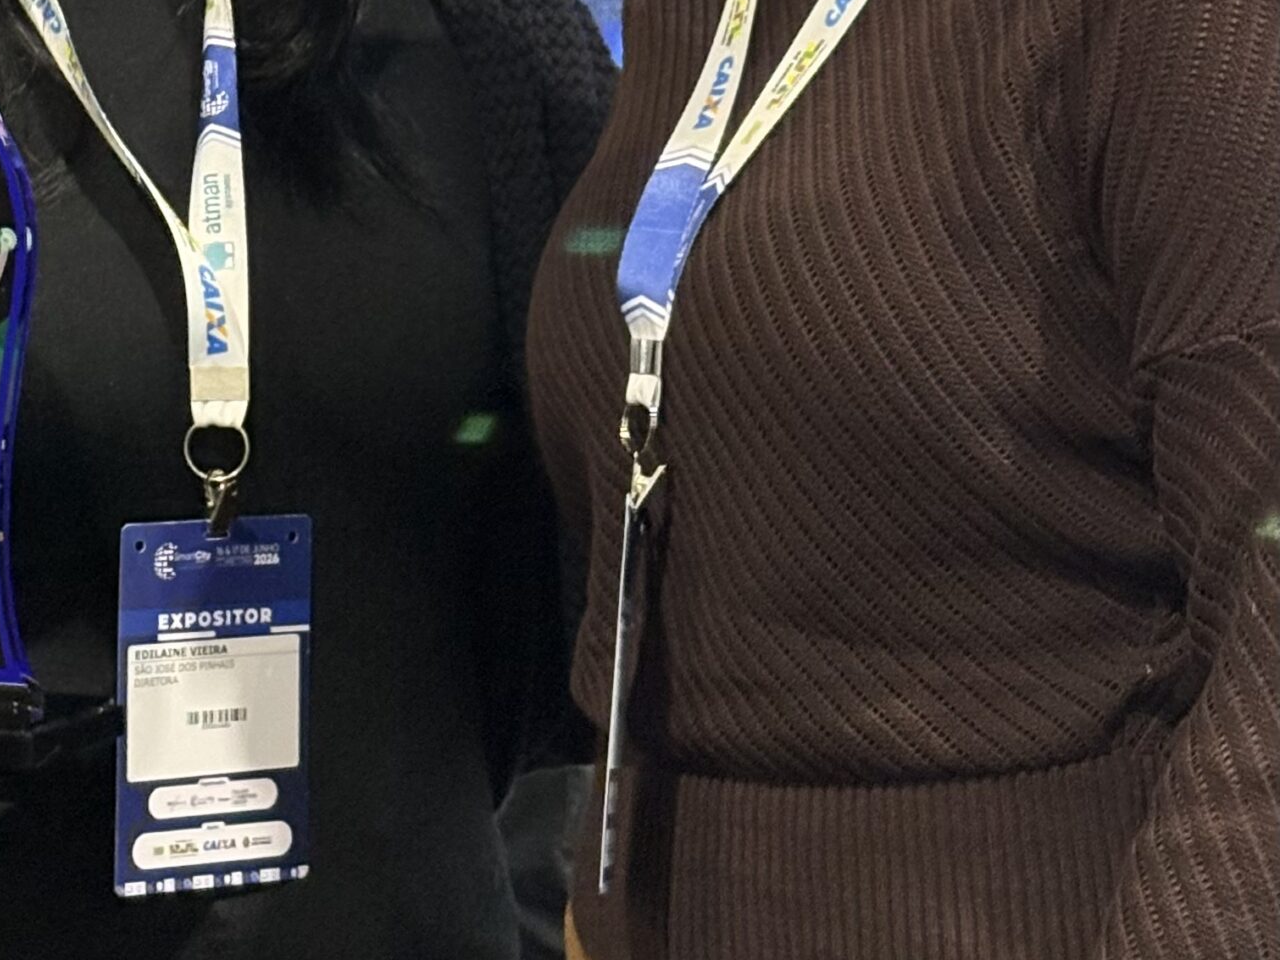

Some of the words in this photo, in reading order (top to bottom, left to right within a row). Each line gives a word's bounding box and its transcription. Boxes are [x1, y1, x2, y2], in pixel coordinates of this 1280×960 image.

[692, 56, 733, 131] CAIXA
[202, 173, 221, 234] atman
[198, 265, 228, 356] CAIXA
[253, 553, 280, 565] 2026
[158, 607, 272, 630] EXPOSITOR
[135, 647, 187, 660] EDILAINE
[190, 644, 228, 656] VIEIRA
[203, 838, 236, 852] CAIXA
